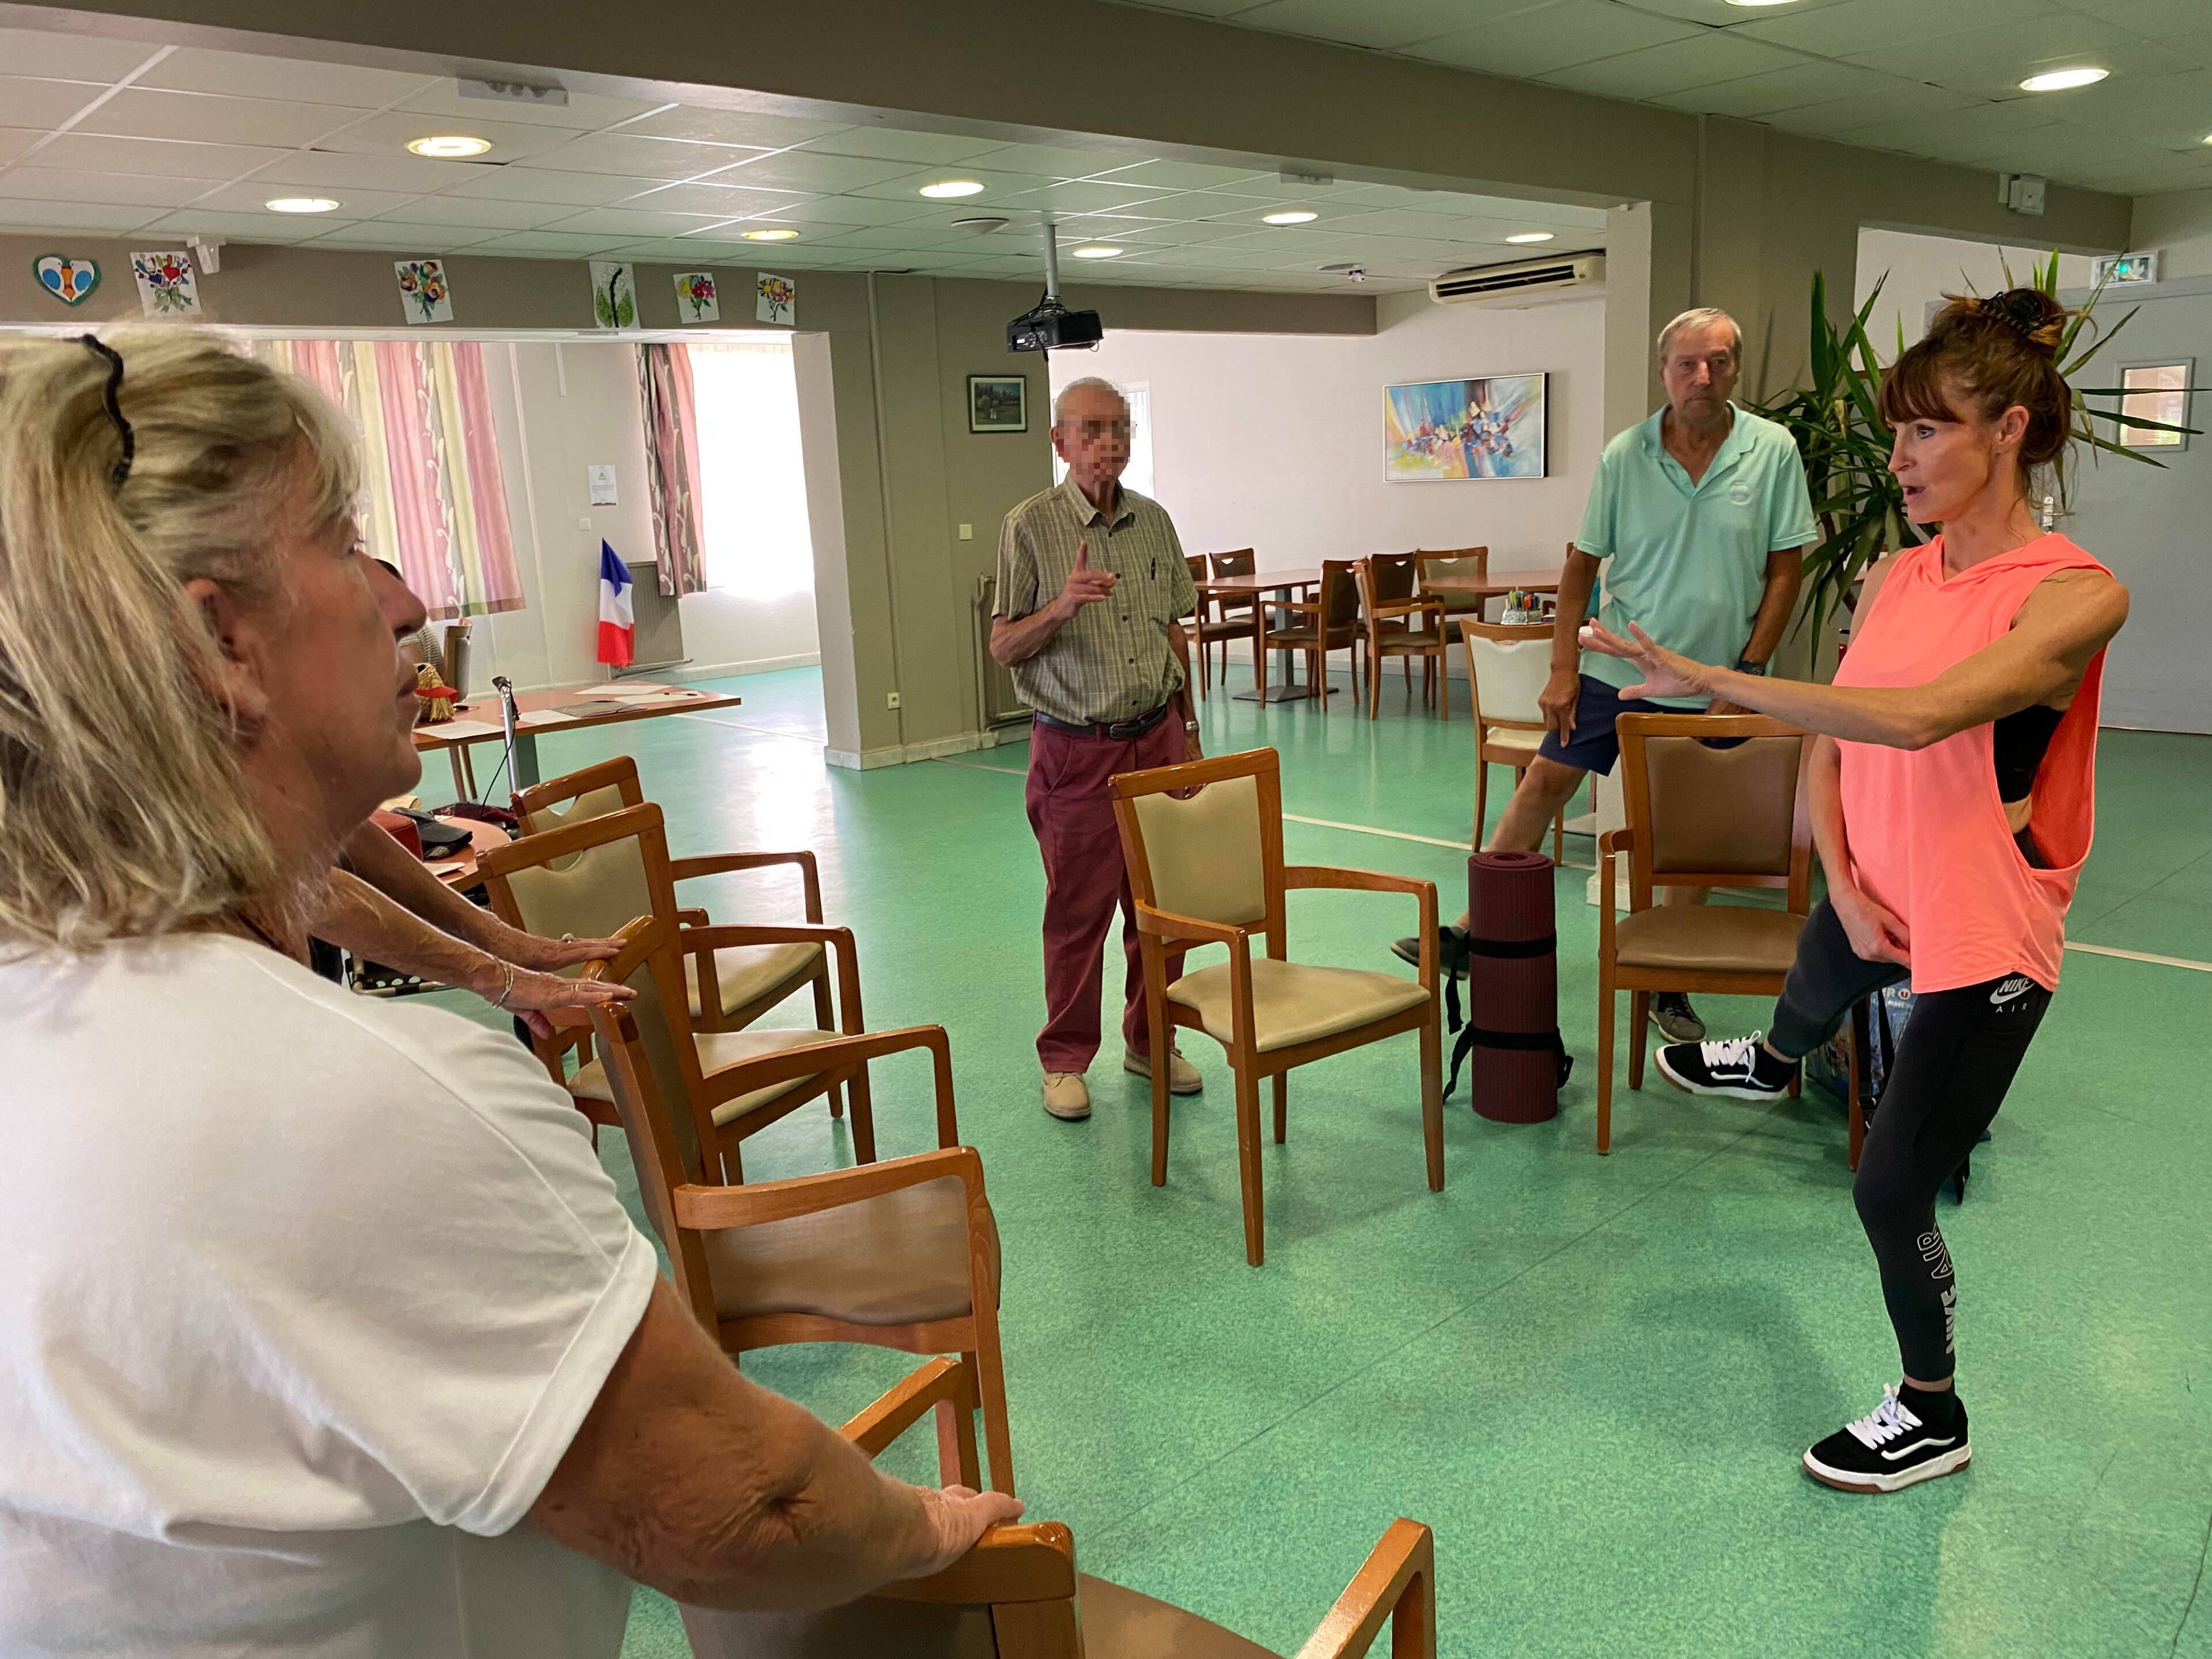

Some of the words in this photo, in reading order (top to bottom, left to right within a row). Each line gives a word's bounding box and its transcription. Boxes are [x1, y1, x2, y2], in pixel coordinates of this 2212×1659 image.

[1998, 978, 2029, 993] NIKE
[1995, 1003, 2027, 1013] AIR
[1917, 1222, 1953, 1279] AIR
